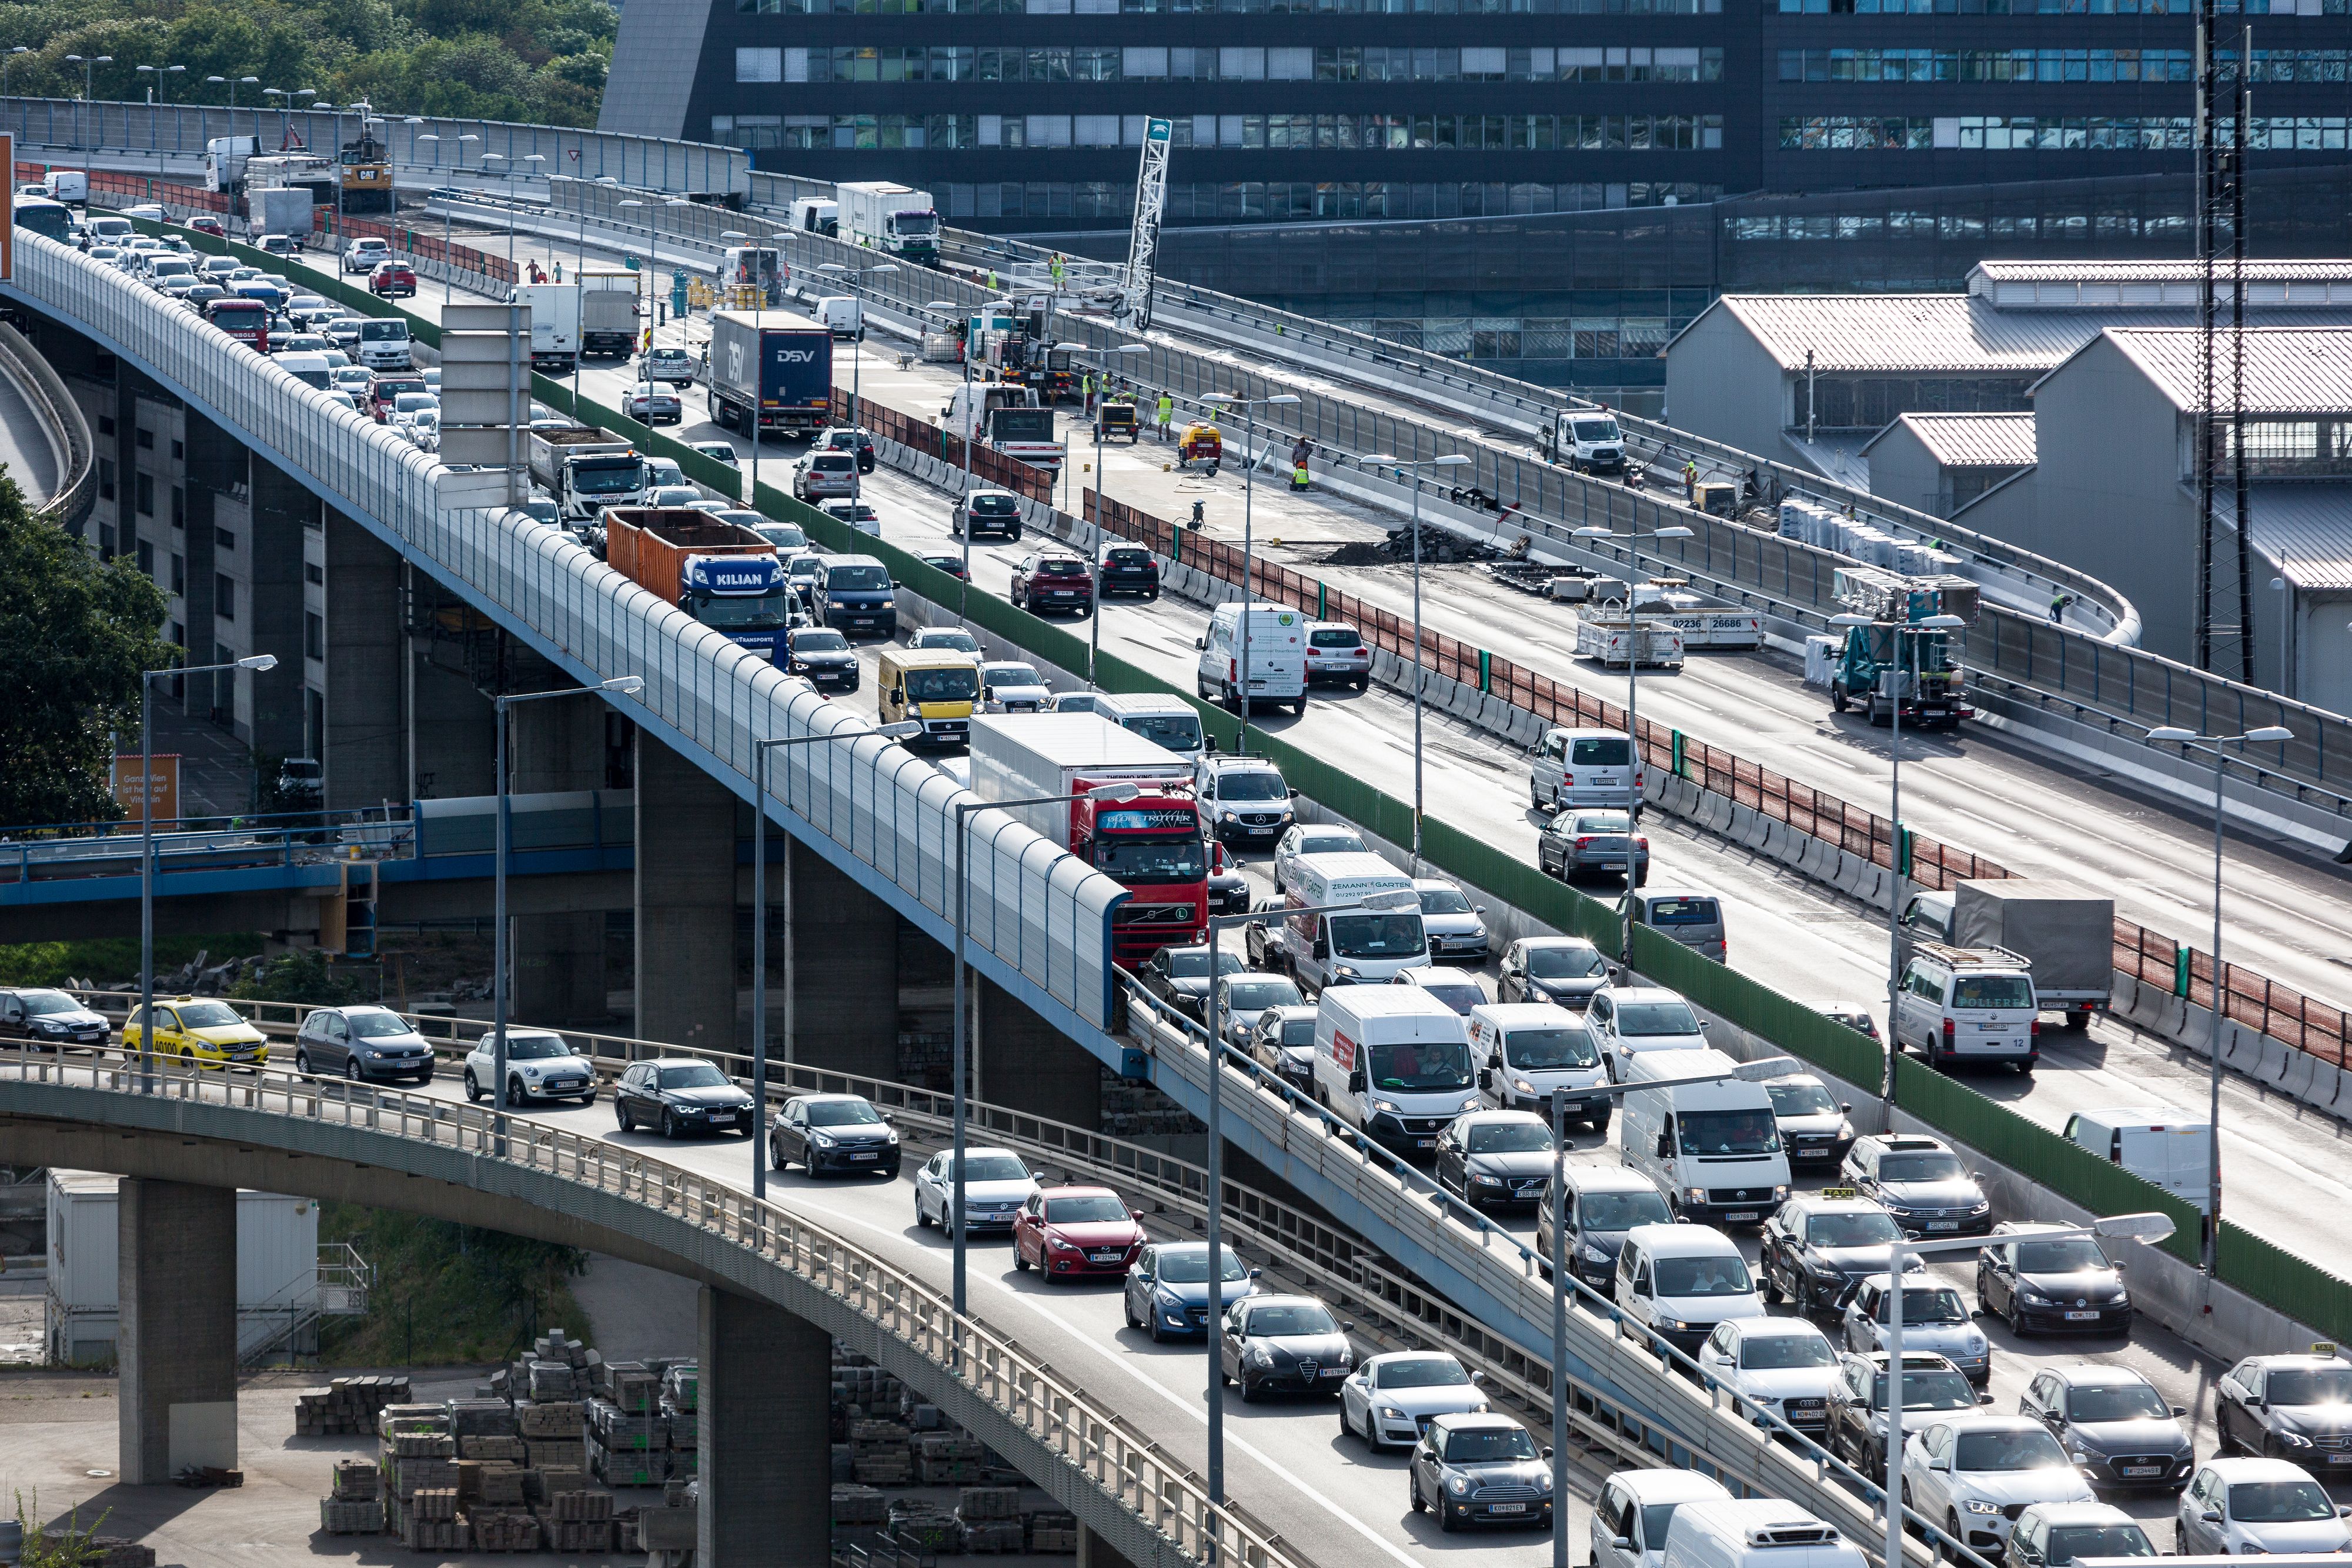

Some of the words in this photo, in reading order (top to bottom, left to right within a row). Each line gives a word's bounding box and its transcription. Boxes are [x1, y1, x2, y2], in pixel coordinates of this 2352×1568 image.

[360, 170, 375, 179] CAT
[777, 350, 814, 362] DSV
[716, 574, 761, 585] KILIAN
[1673, 619, 1701, 628] 02236
[1712, 619, 1741, 628] 26686
[123, 775, 143, 783] Ganz
[1289, 866, 1305, 887] ZEMANN
[1307, 879, 1325, 900] GARTEN
[155, 1041, 176, 1055] 40100
[2013, 1039, 2023, 1047] 12
